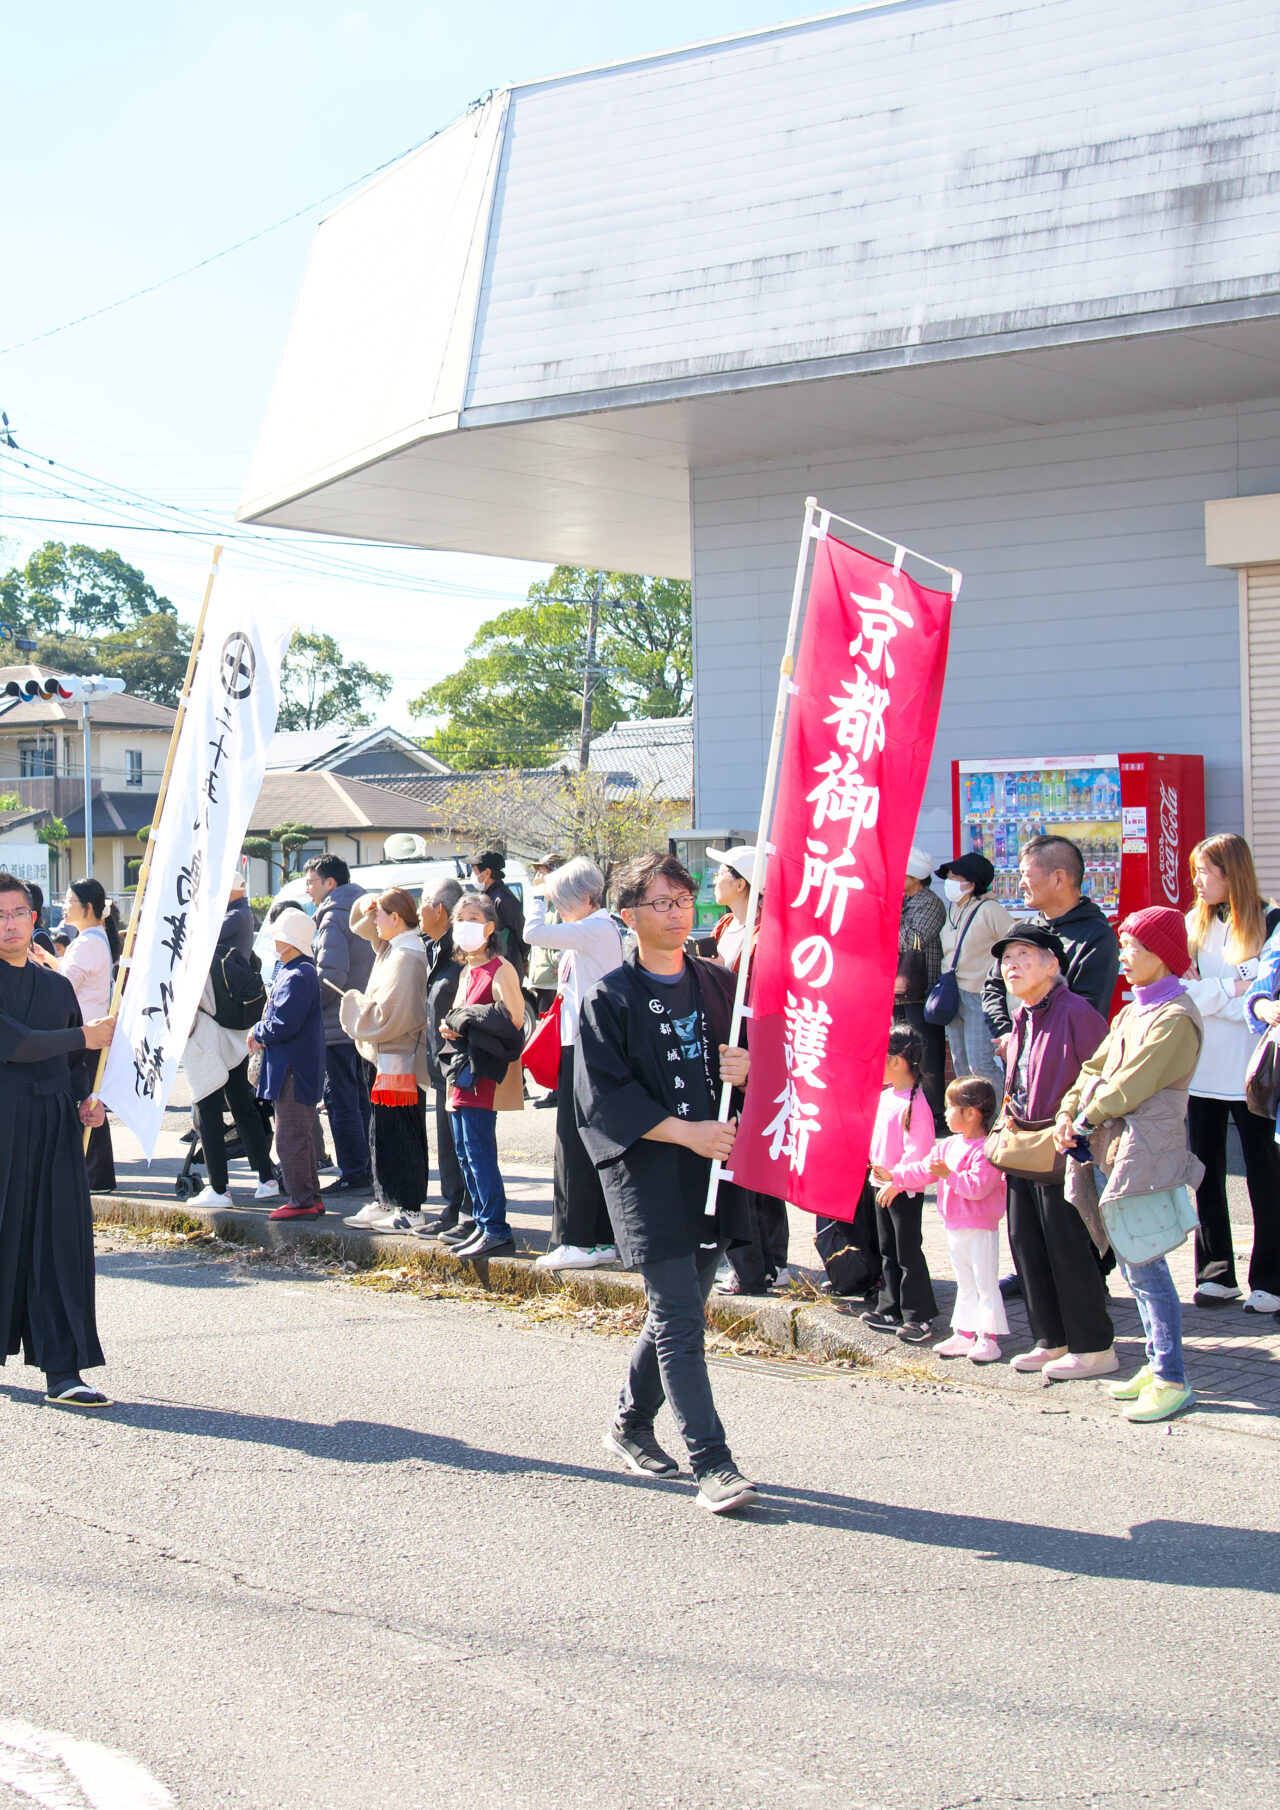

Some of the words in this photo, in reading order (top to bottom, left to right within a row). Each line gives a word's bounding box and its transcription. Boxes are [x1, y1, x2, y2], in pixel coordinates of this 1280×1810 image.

[761, 582, 914, 1177] 京都御所の護衛
[1159, 777, 1180, 905] Coca-Cola
[660, 1022, 690, 1116] 都城島津
